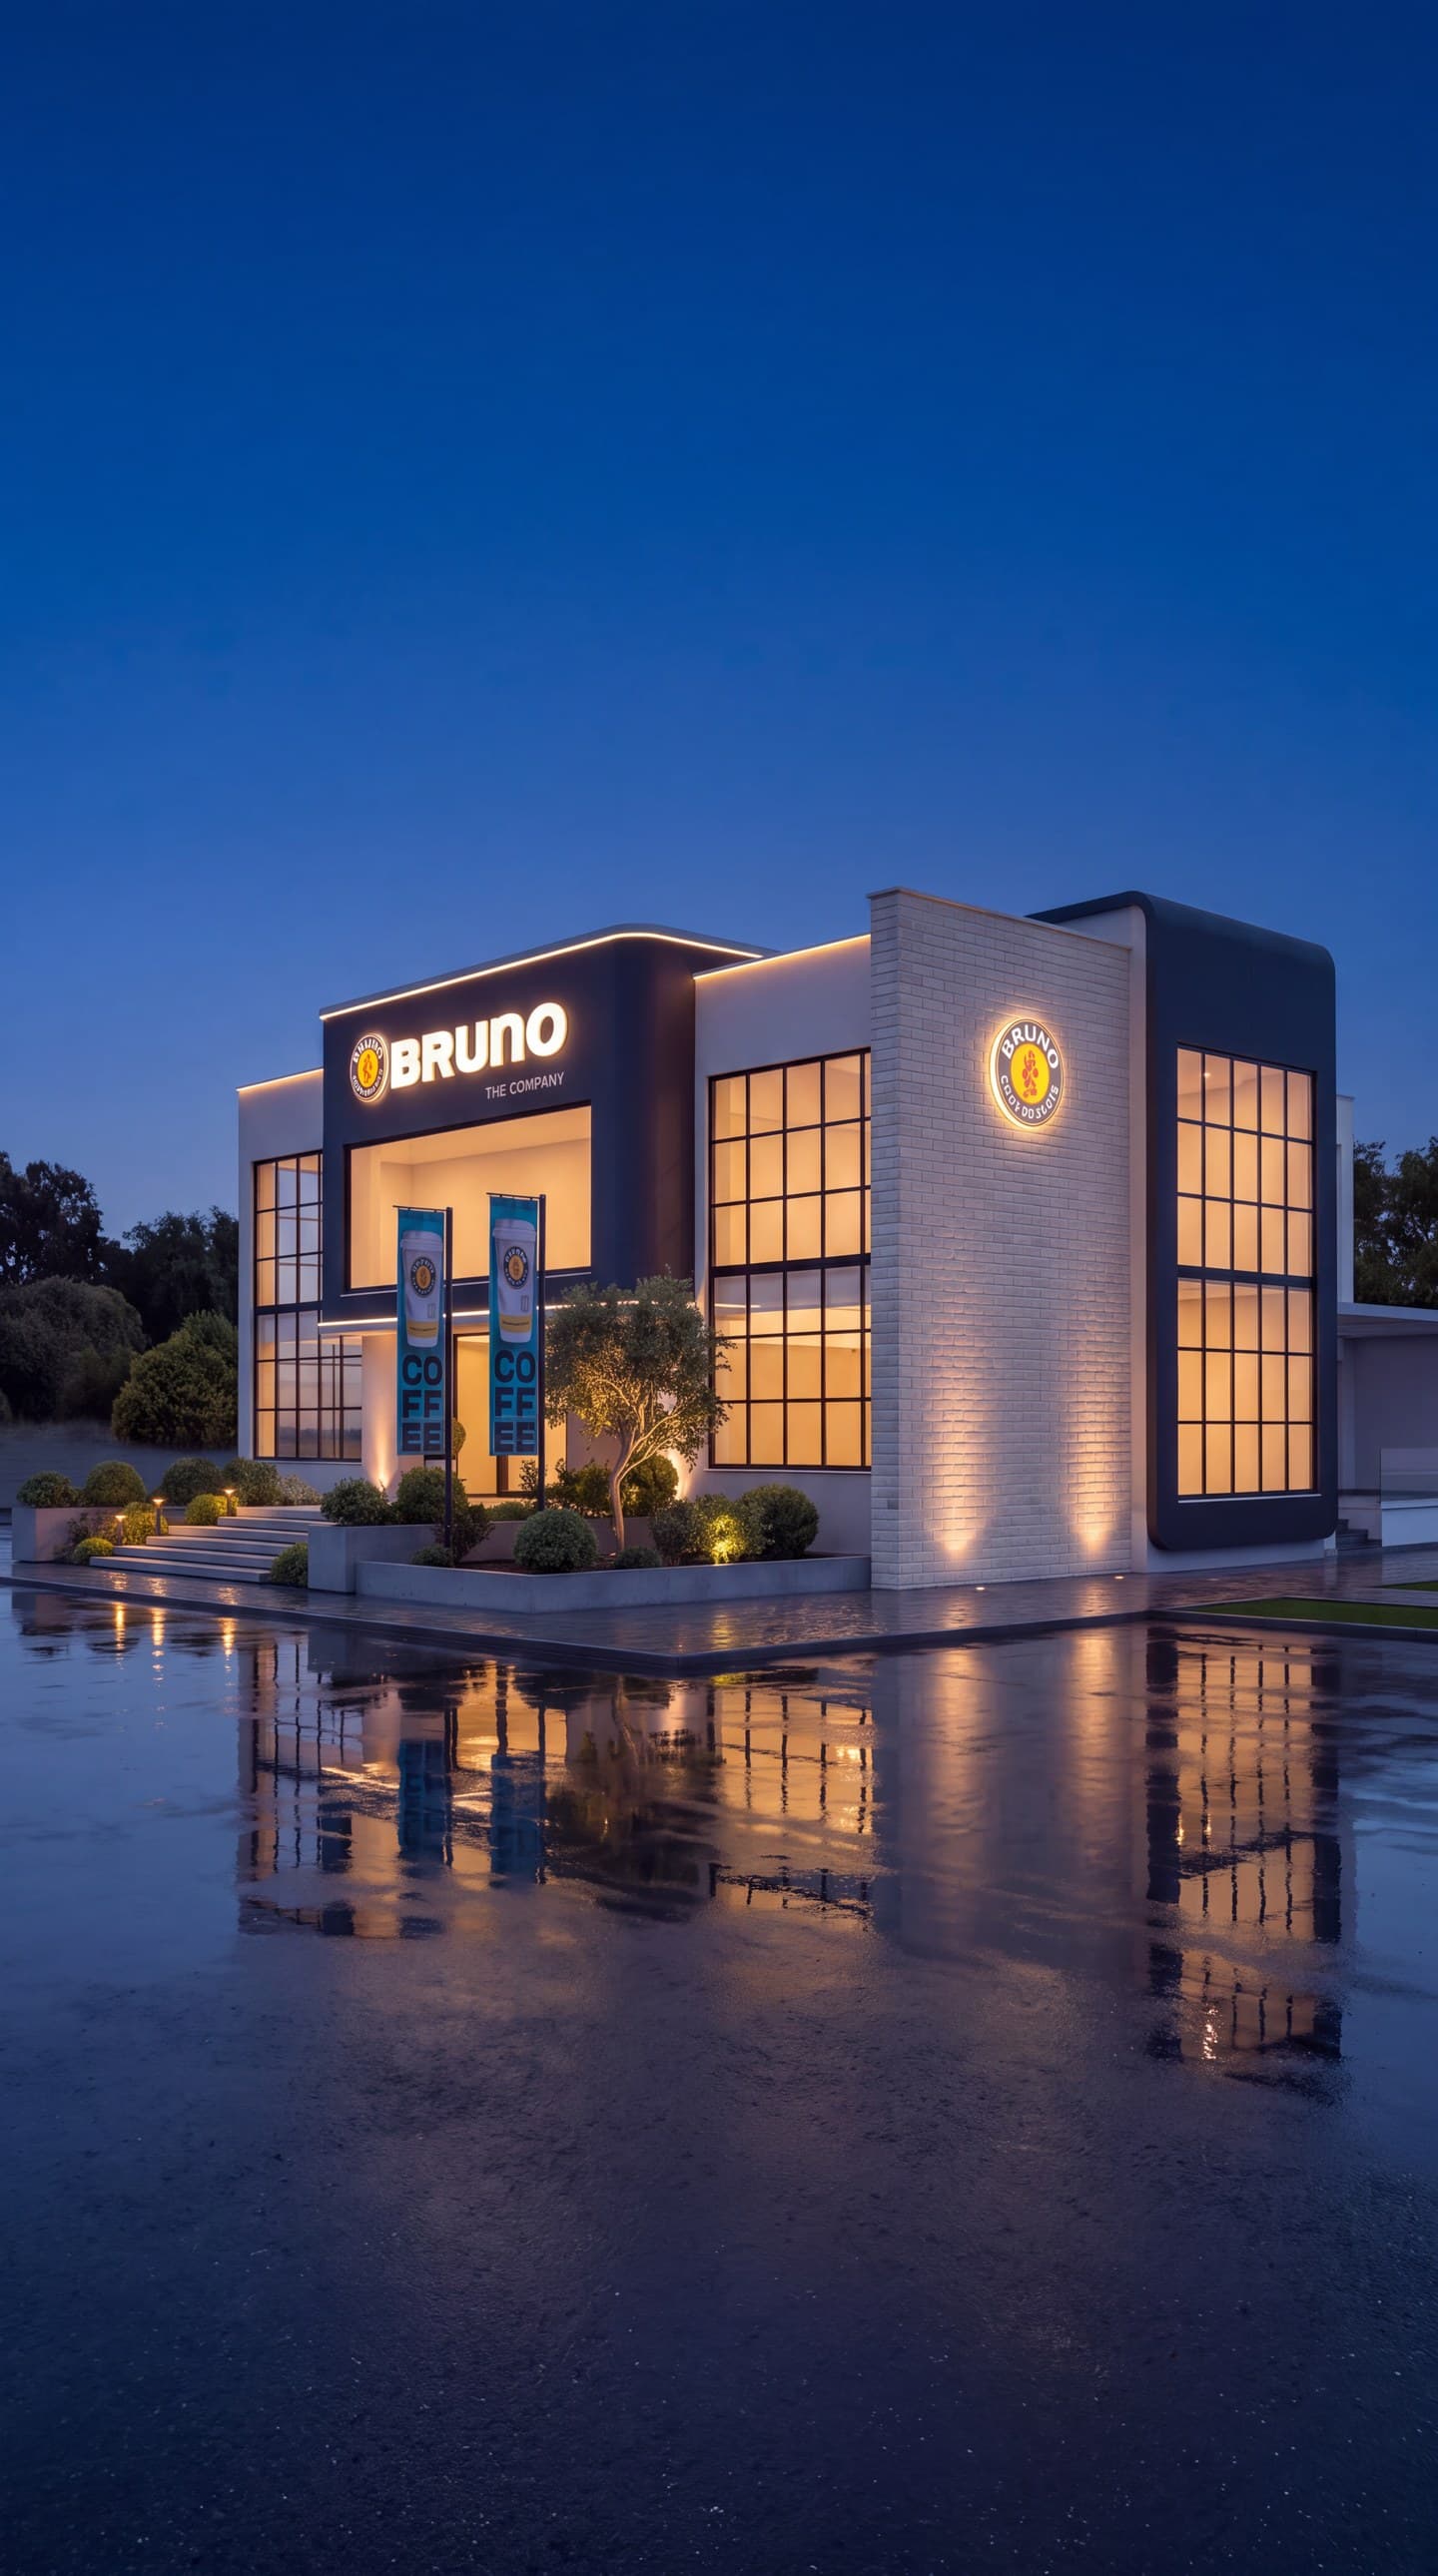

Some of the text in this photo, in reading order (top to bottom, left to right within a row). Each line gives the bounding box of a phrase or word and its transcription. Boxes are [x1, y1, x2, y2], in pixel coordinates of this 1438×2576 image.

[1001, 1024, 1060, 1069] BRUNO
[484, 1071, 565, 1100] THE COMPANY
